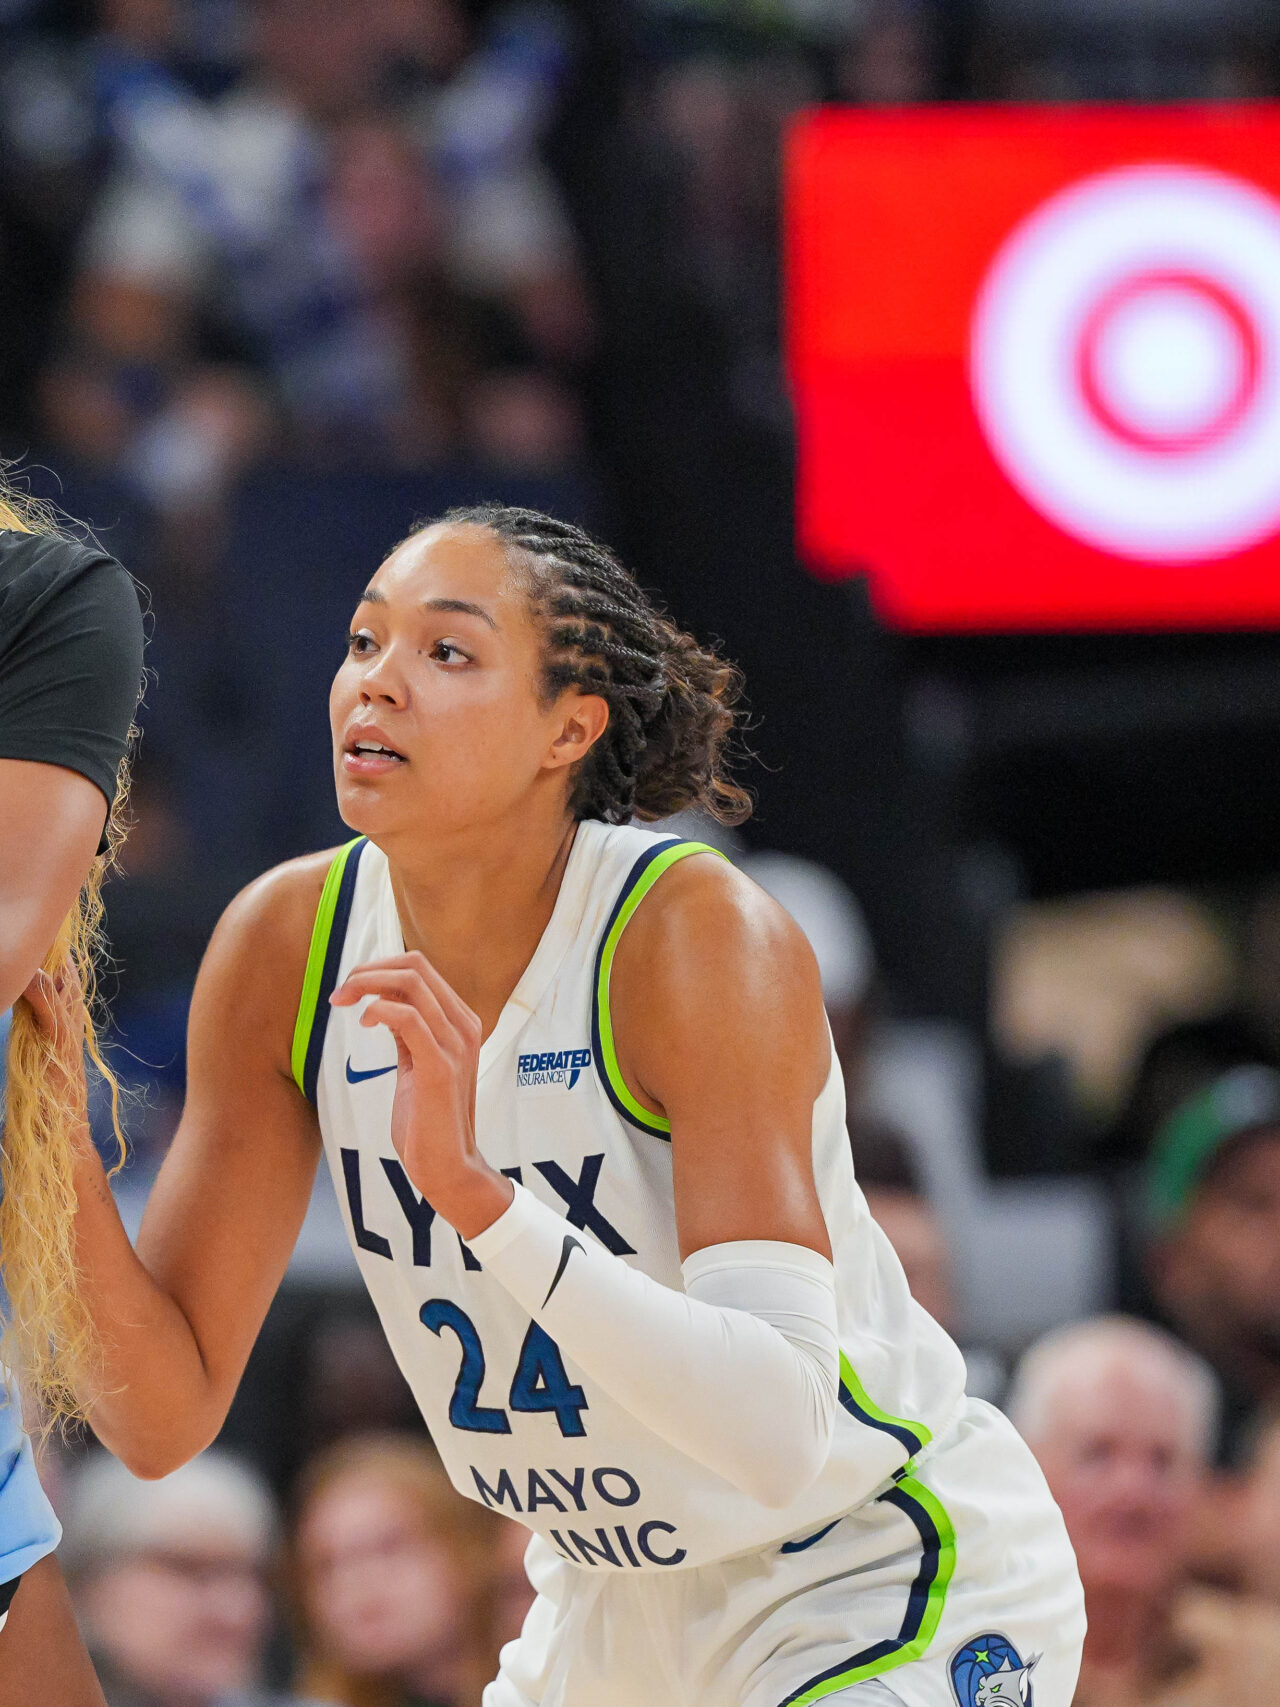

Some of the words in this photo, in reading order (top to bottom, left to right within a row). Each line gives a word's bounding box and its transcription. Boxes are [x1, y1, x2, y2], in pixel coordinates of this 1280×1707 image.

[516, 1070, 564, 1088] INSURANCE
[517, 1048, 592, 1074] FEDERATED
[419, 1298, 589, 1437] 24
[469, 1465, 641, 1513] MAYO
[549, 1520, 688, 1568] INIC
